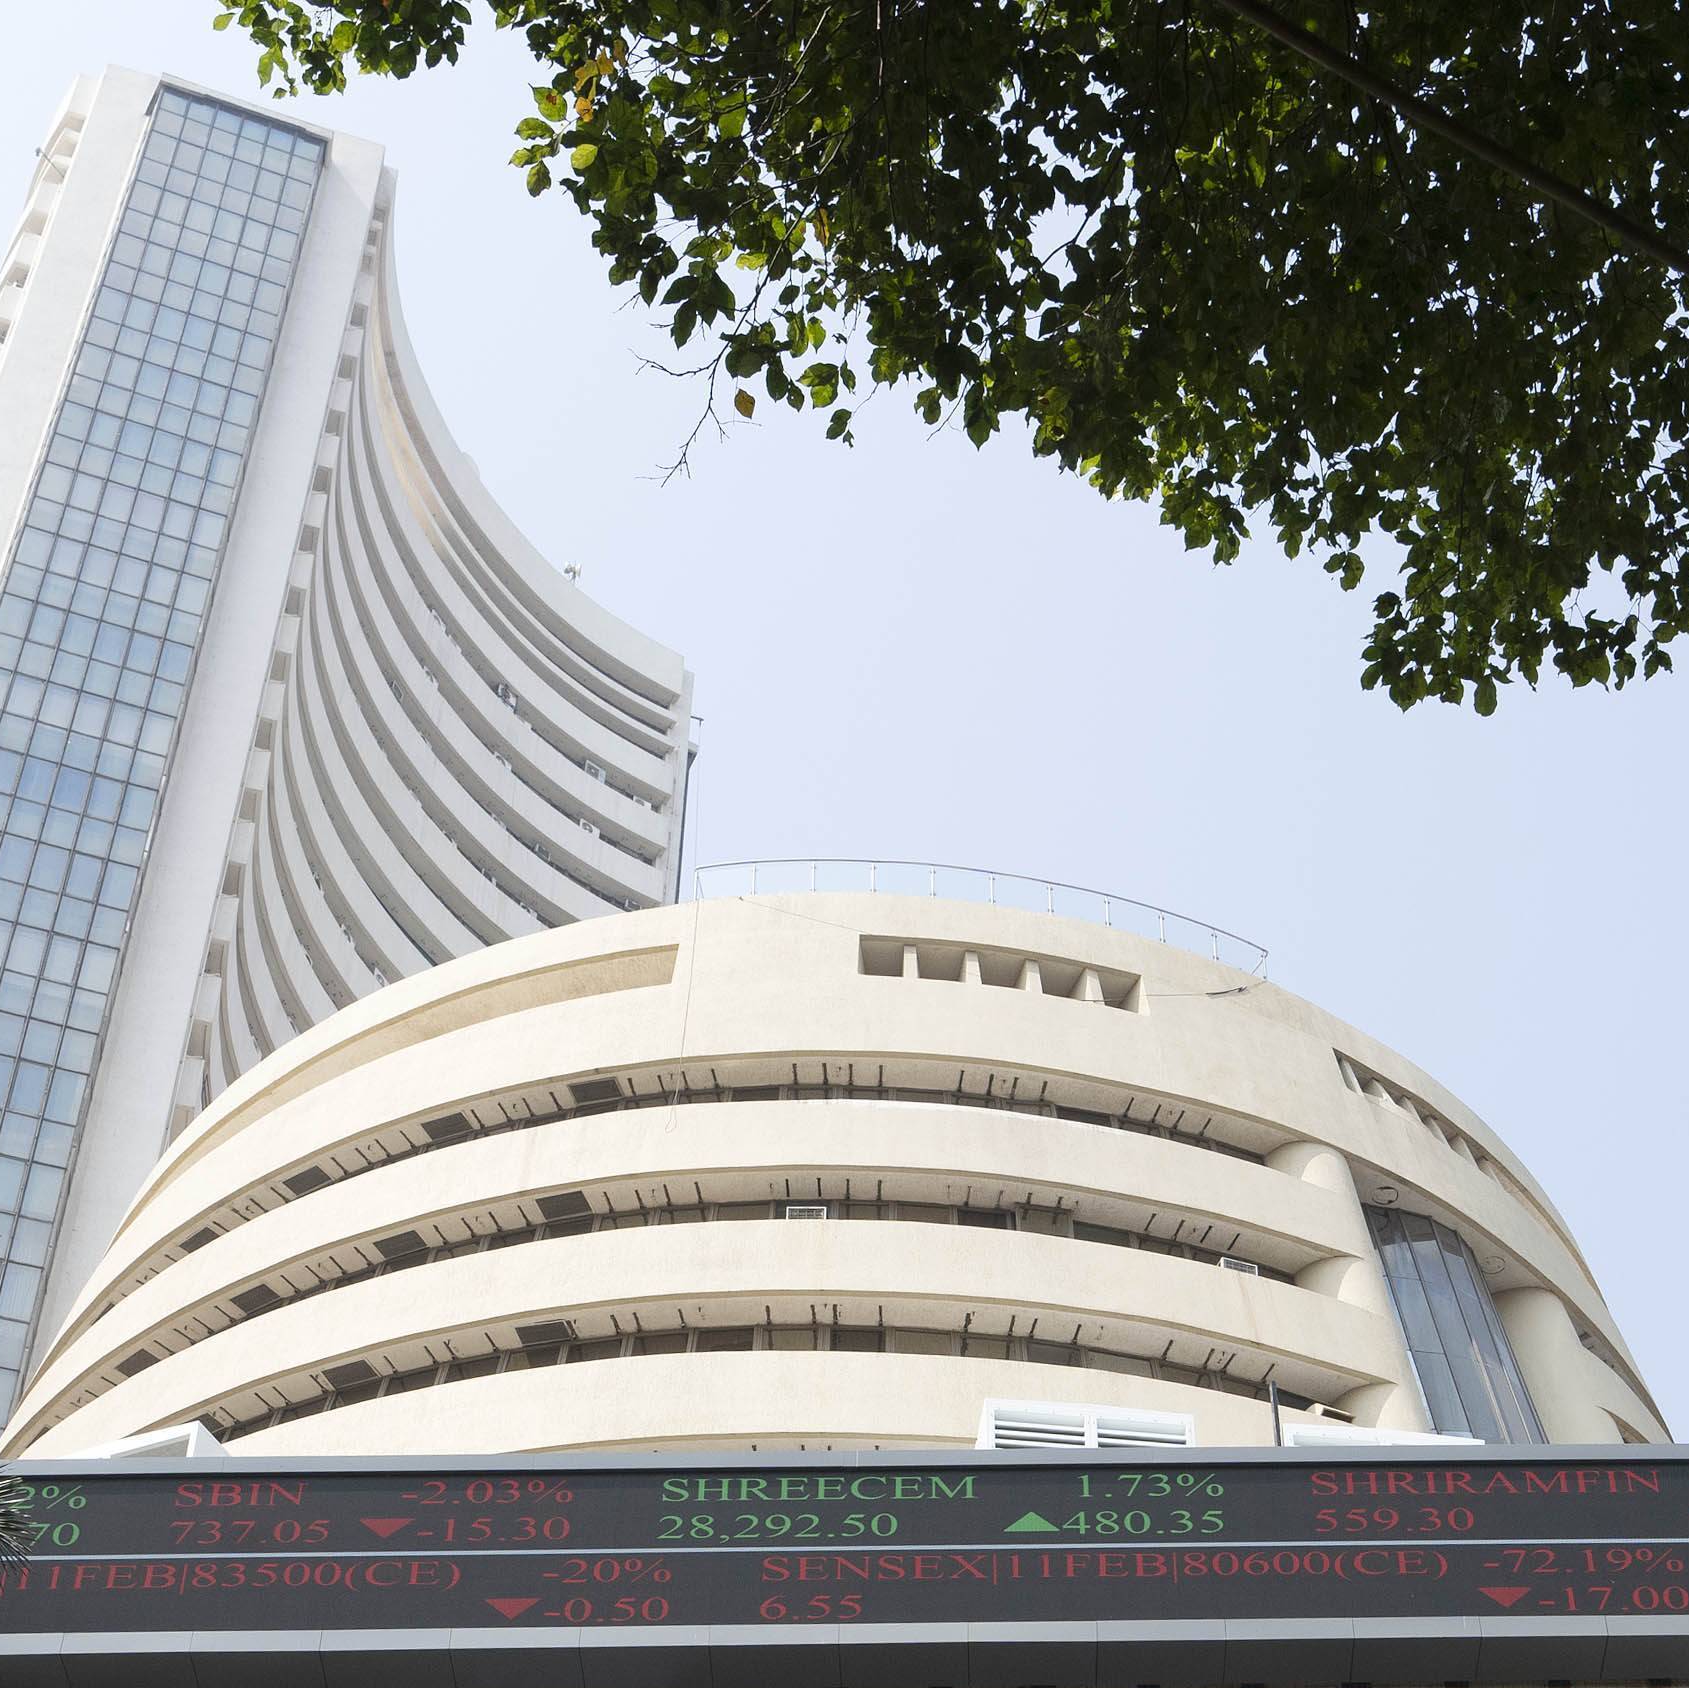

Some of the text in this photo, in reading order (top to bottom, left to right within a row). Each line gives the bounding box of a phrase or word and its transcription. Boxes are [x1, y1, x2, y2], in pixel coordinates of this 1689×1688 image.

[175, 1479, 575, 1509] SBIN -2.03%
[660, 1473, 1225, 1502] SHREECEM 1.73%
[1312, 1468, 1662, 1497] SHRIRAMFIN
[169, 1516, 572, 1545] 737.05 -15.30
[656, 1510, 1225, 1544] 28,292.50 480.35
[1314, 1506, 1475, 1533] 559.30
[542, 1556, 671, 1585] -20%
[1483, 1546, 1685, 1574] -72.19%
[543, 1597, 669, 1624] -0.50
[759, 1594, 864, 1621] 6.55
[1538, 1585, 1689, 1611] -17.00
